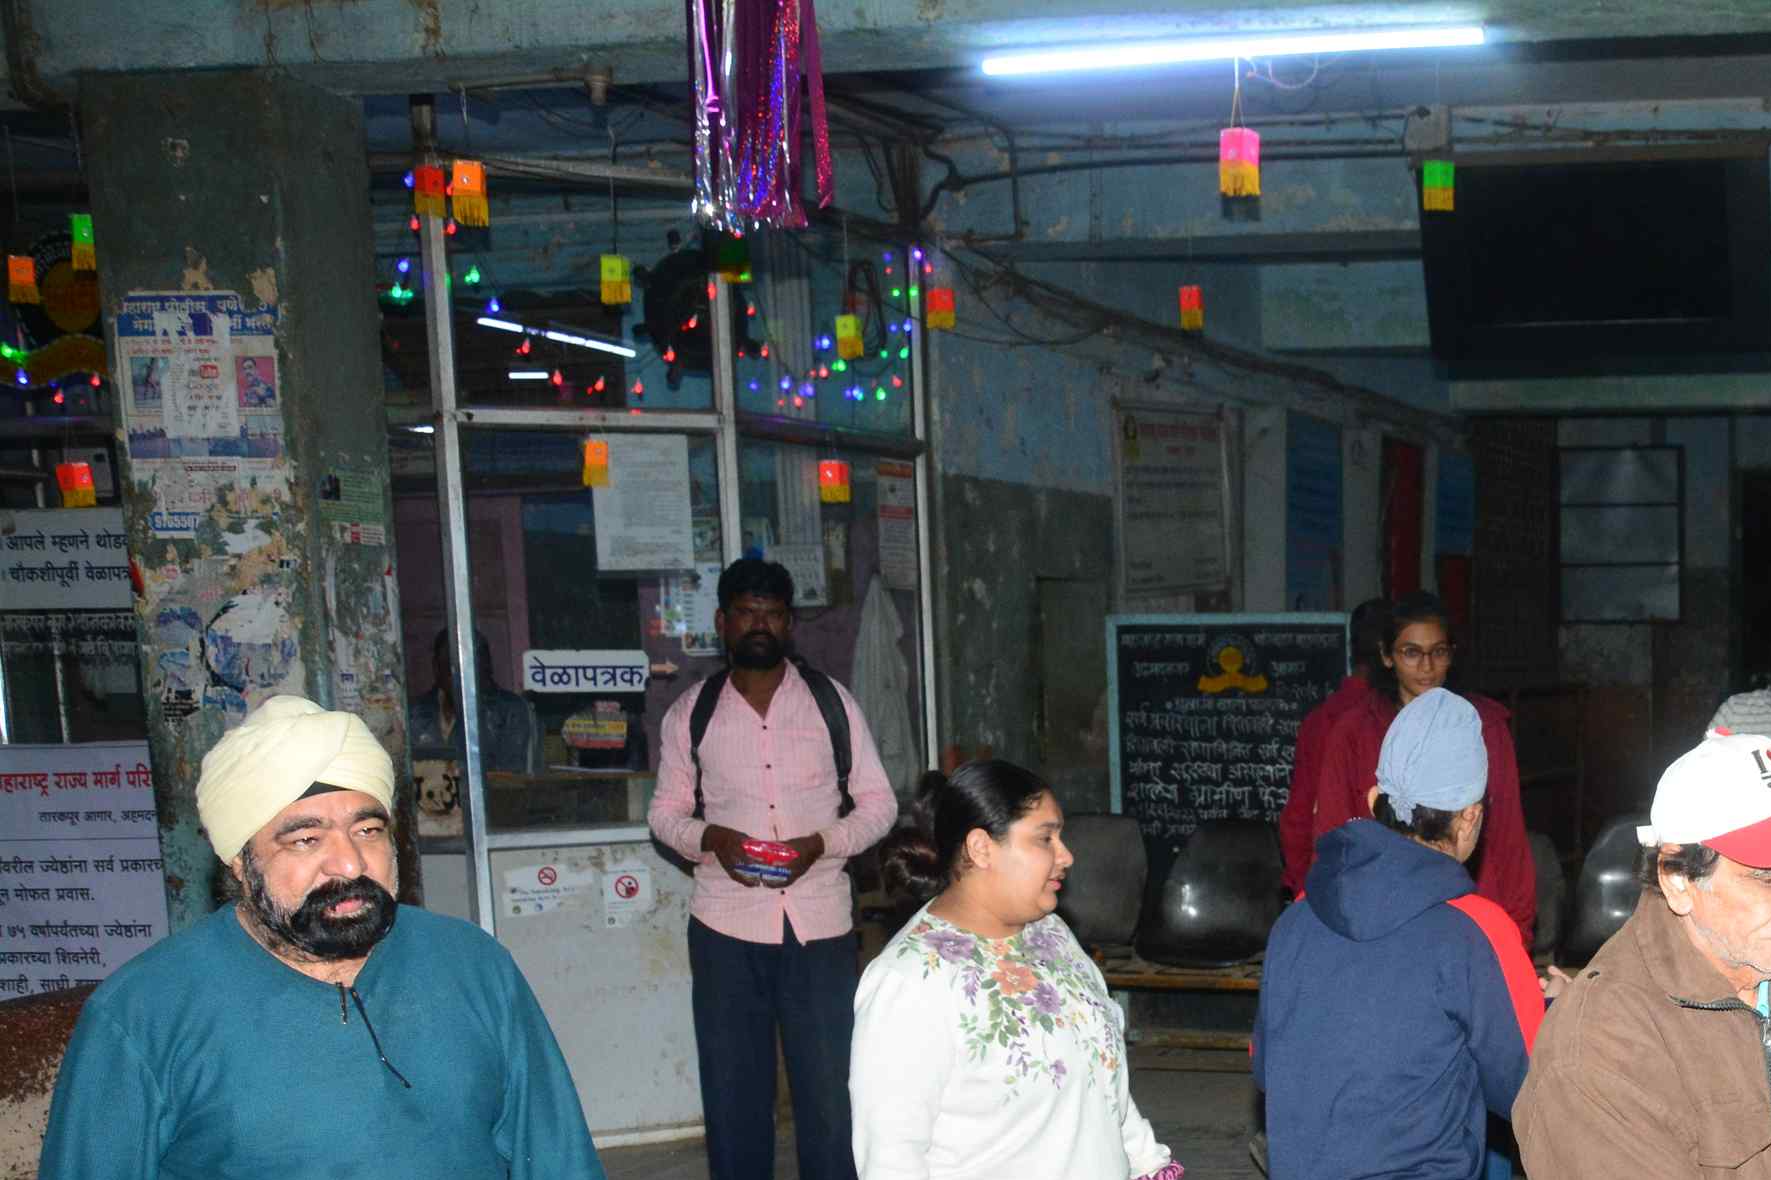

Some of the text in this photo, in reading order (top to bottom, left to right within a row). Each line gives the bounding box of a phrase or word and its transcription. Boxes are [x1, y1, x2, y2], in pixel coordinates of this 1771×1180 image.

[529, 656, 644, 687] वेळापत्रक
[1751, 749, 1767, 773] I
[53, 772, 88, 790] राज्य
[92, 764, 121, 789] मार्ग
[126, 763, 152, 789] परि
[93, 855, 115, 873] सर्व
[14, 884, 96, 902] मोफत प्रवास.
